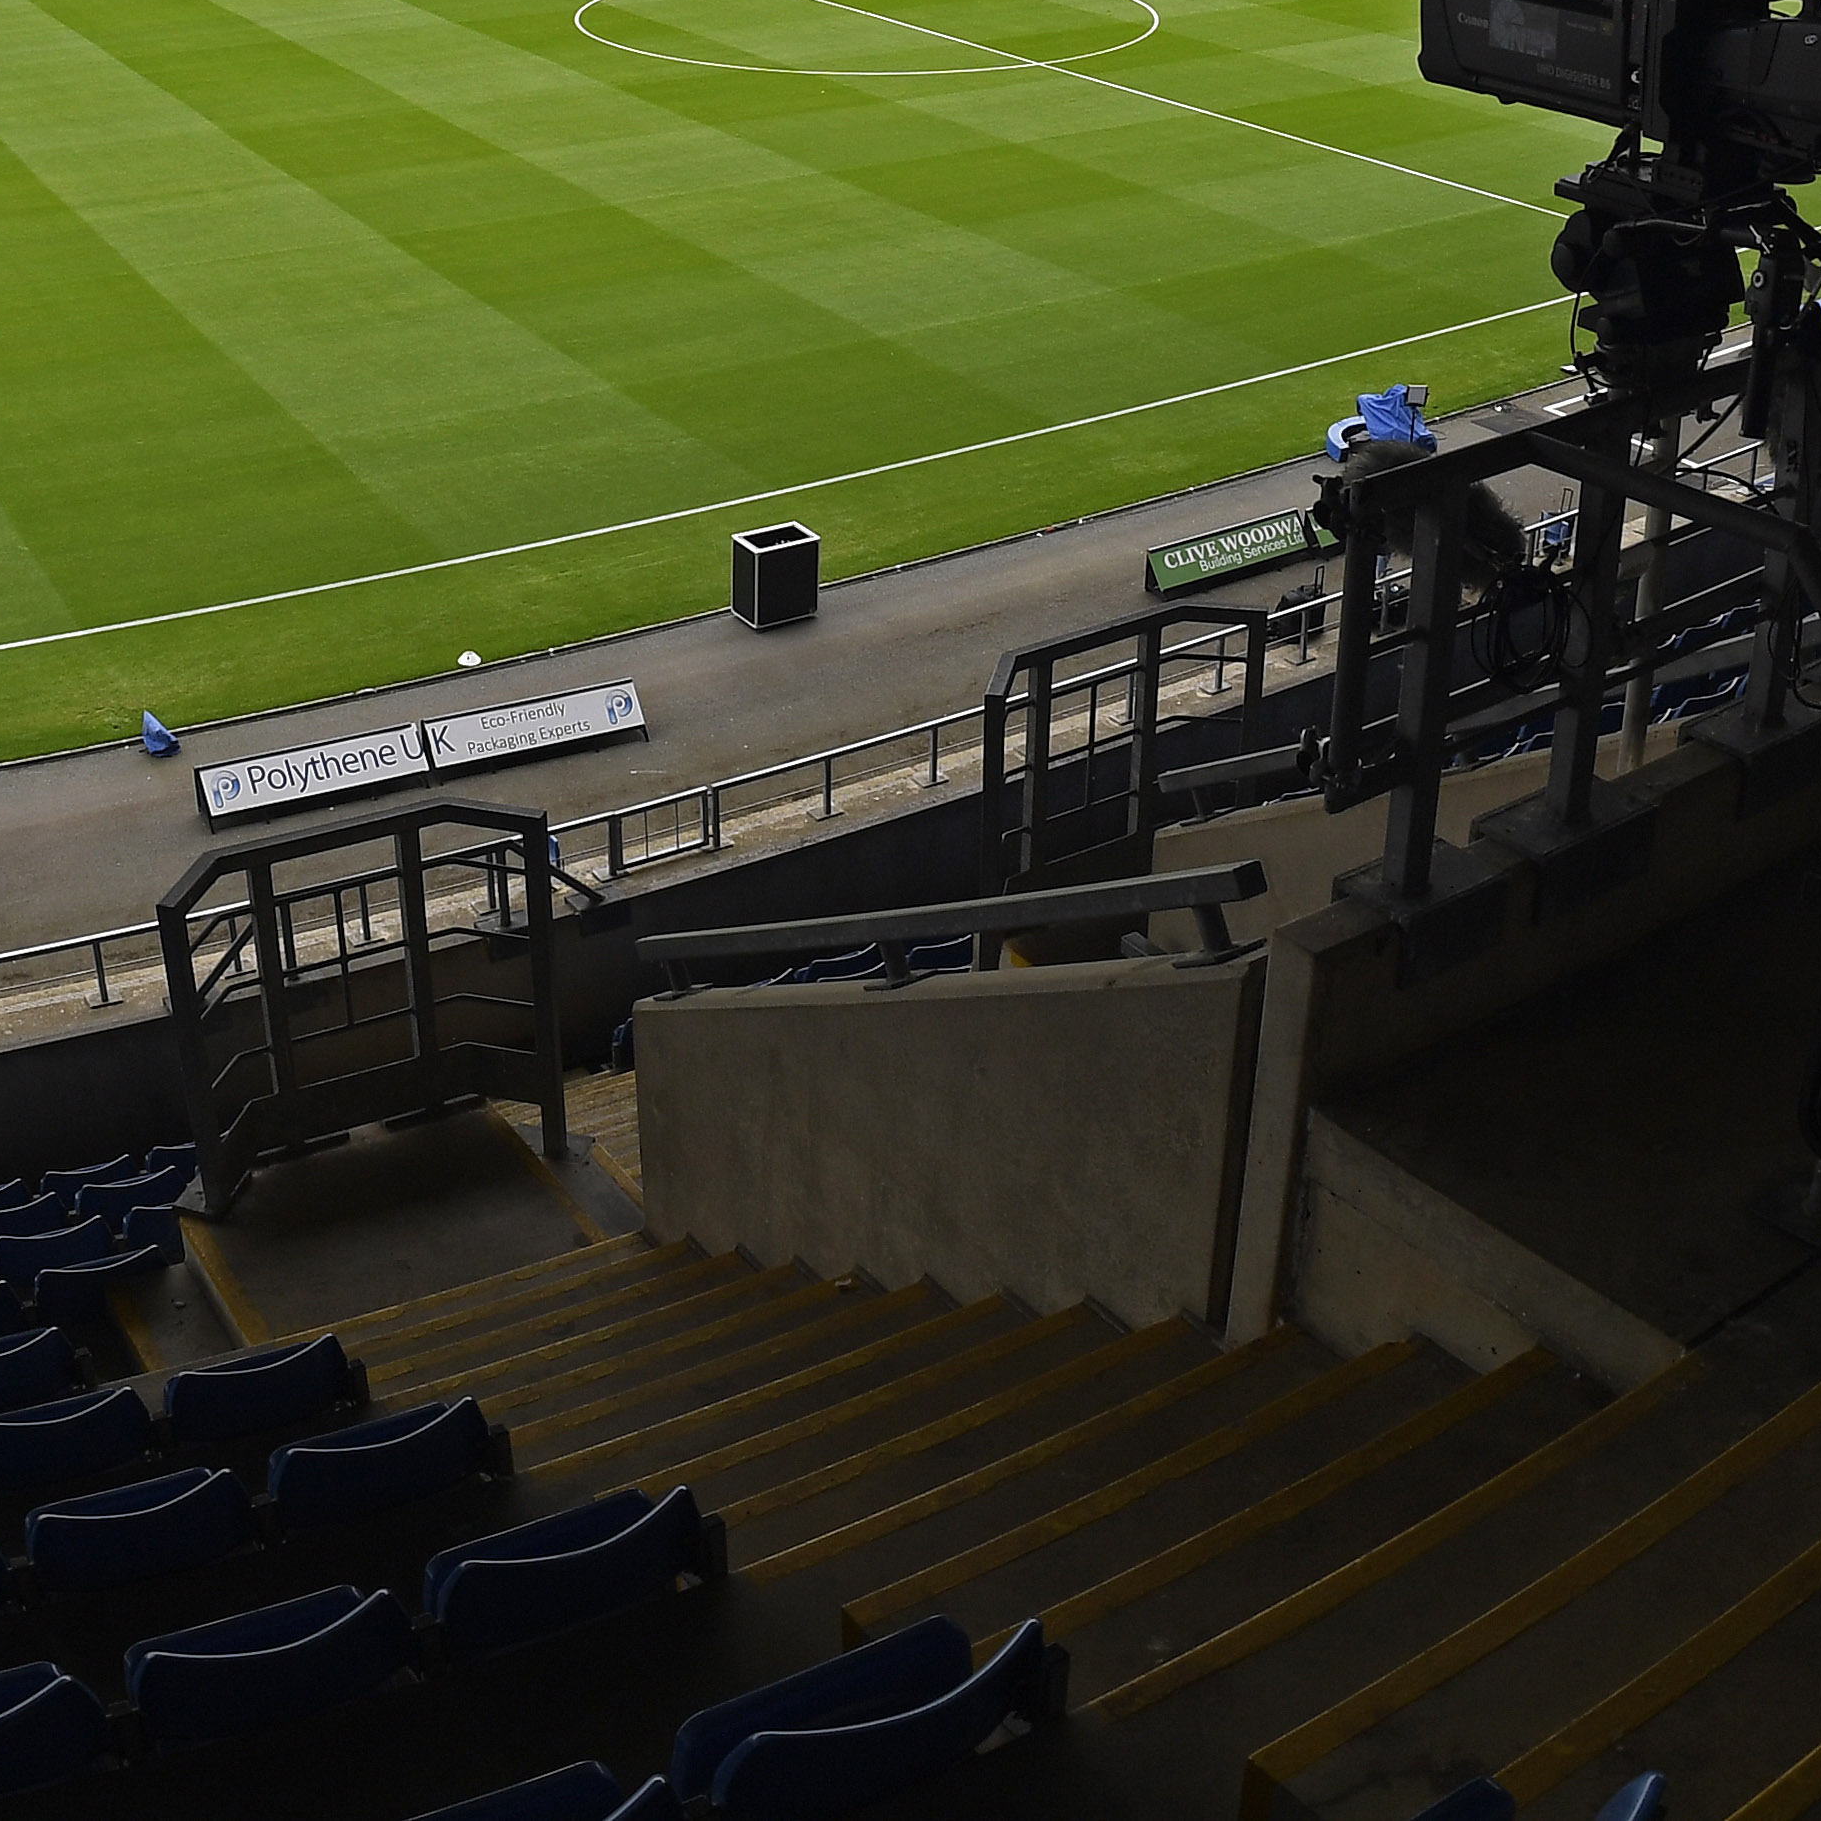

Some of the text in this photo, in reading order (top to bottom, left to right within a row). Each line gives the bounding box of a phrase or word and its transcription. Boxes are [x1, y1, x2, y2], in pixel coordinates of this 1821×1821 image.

[1458, 12, 1490, 29] Canon
[1555, 66, 1599, 88] DIGISUPER
[1163, 539, 1220, 570] CLIVE
[1198, 533, 1306, 573] Building Services Ltd
[480, 702, 568, 731] Eco-Friendly
[466, 718, 592, 757] Packaging Experts
[245, 740, 398, 796] Polythene
